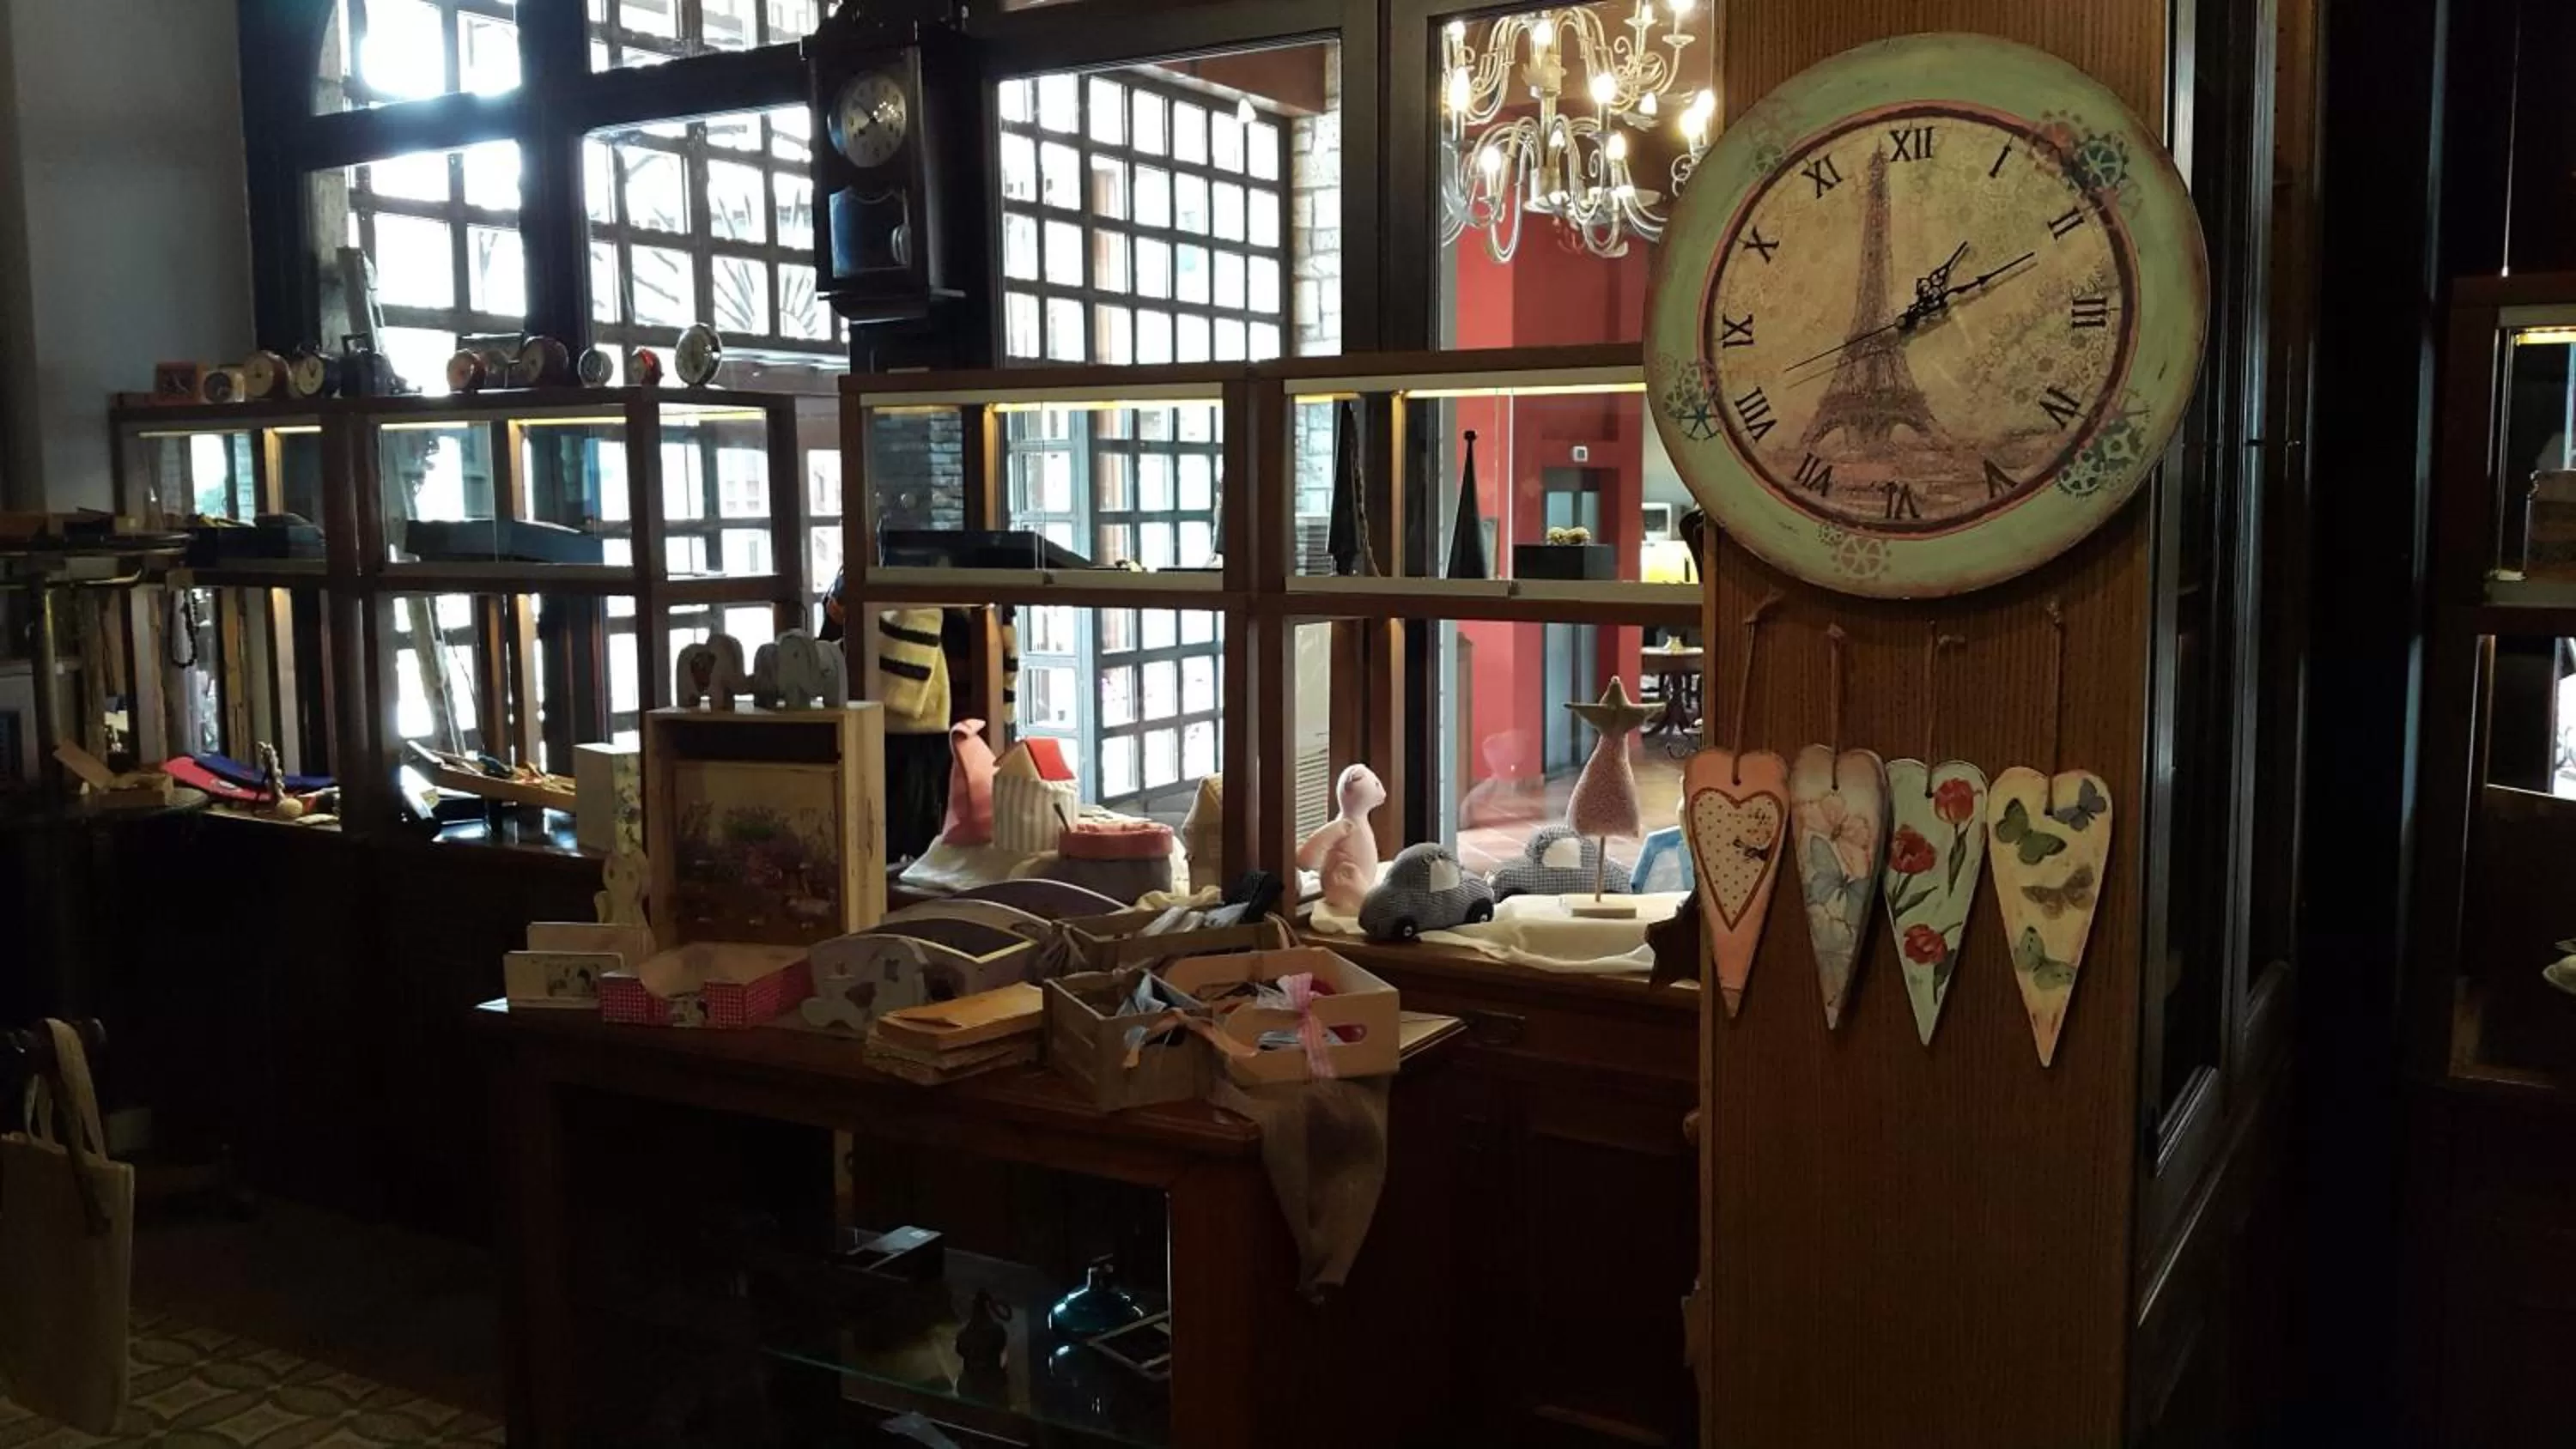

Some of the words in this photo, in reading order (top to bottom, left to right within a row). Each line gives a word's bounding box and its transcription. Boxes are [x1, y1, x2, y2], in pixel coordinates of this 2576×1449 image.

[1890, 126, 1934, 163] XII
[1989, 144, 2012, 179] I
[1802, 153, 1843, 198] XI
[2047, 206, 2085, 241] II
[1743, 226, 1780, 264] X
[1721, 312, 1754, 349] IX
[2072, 296, 2107, 330] III
[1734, 386, 1777, 442] VIII
[2038, 386, 2081, 429] IV
[1793, 452, 1834, 498] VII
[1982, 459, 2019, 500] V
[1884, 480, 1921, 520] VI
